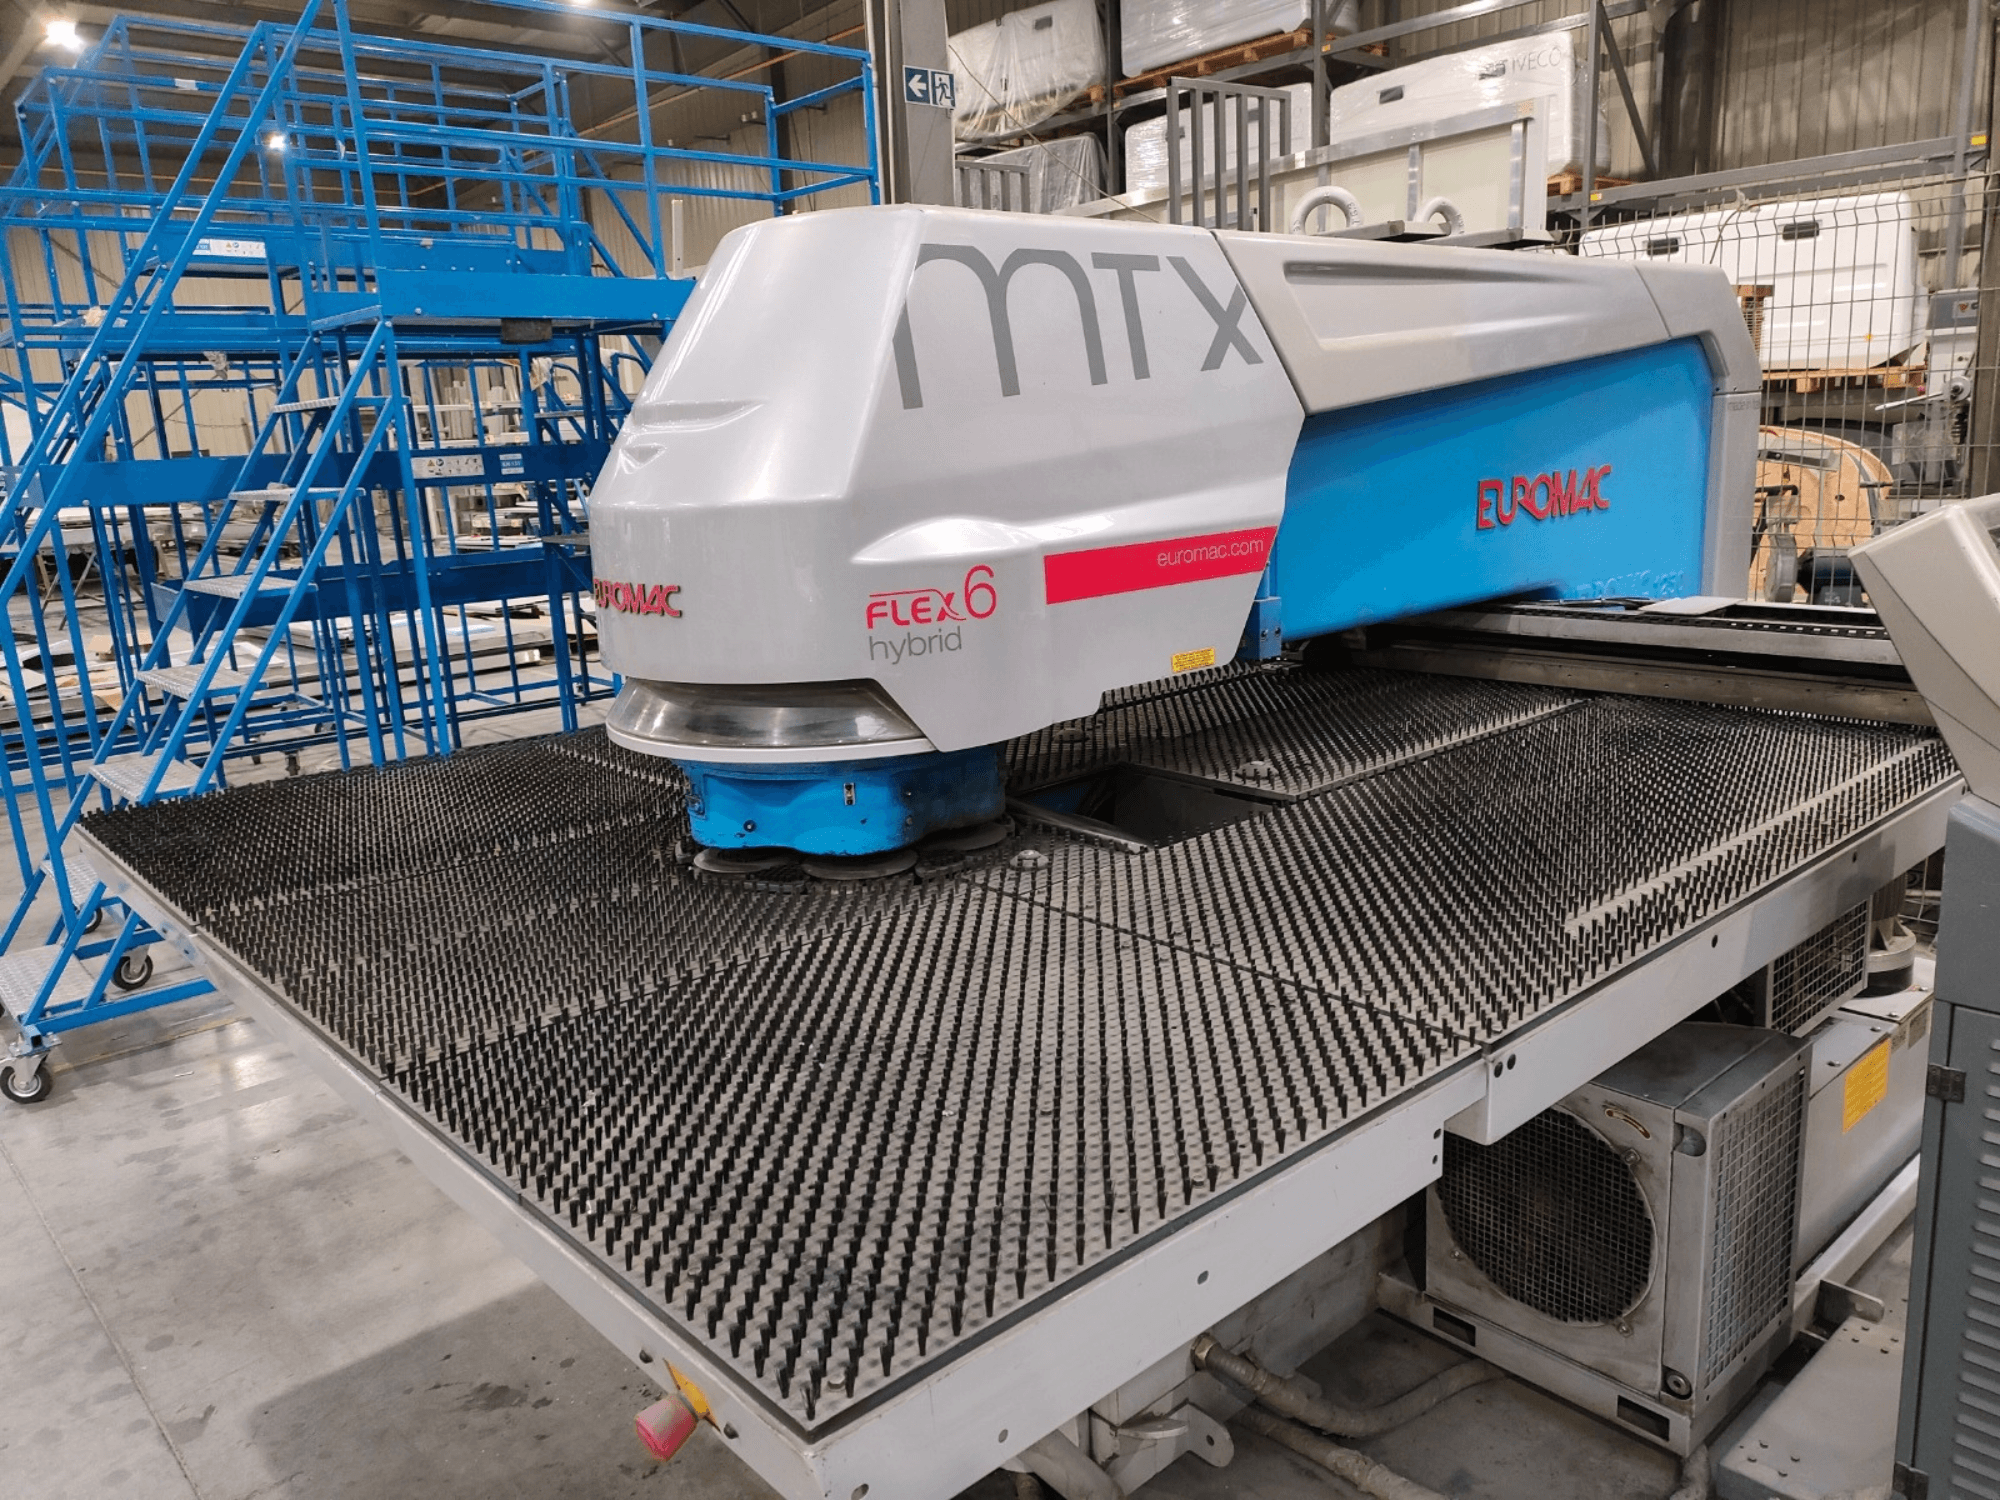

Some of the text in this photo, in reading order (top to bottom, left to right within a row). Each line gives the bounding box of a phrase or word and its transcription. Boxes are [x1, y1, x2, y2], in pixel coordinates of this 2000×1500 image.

[1512, 46, 1561, 73] IVECO
[1477, 464, 1612, 530] EUROMAC
[1157, 540, 1264, 567] euromac.com
[868, 625, 962, 665] hybrid
